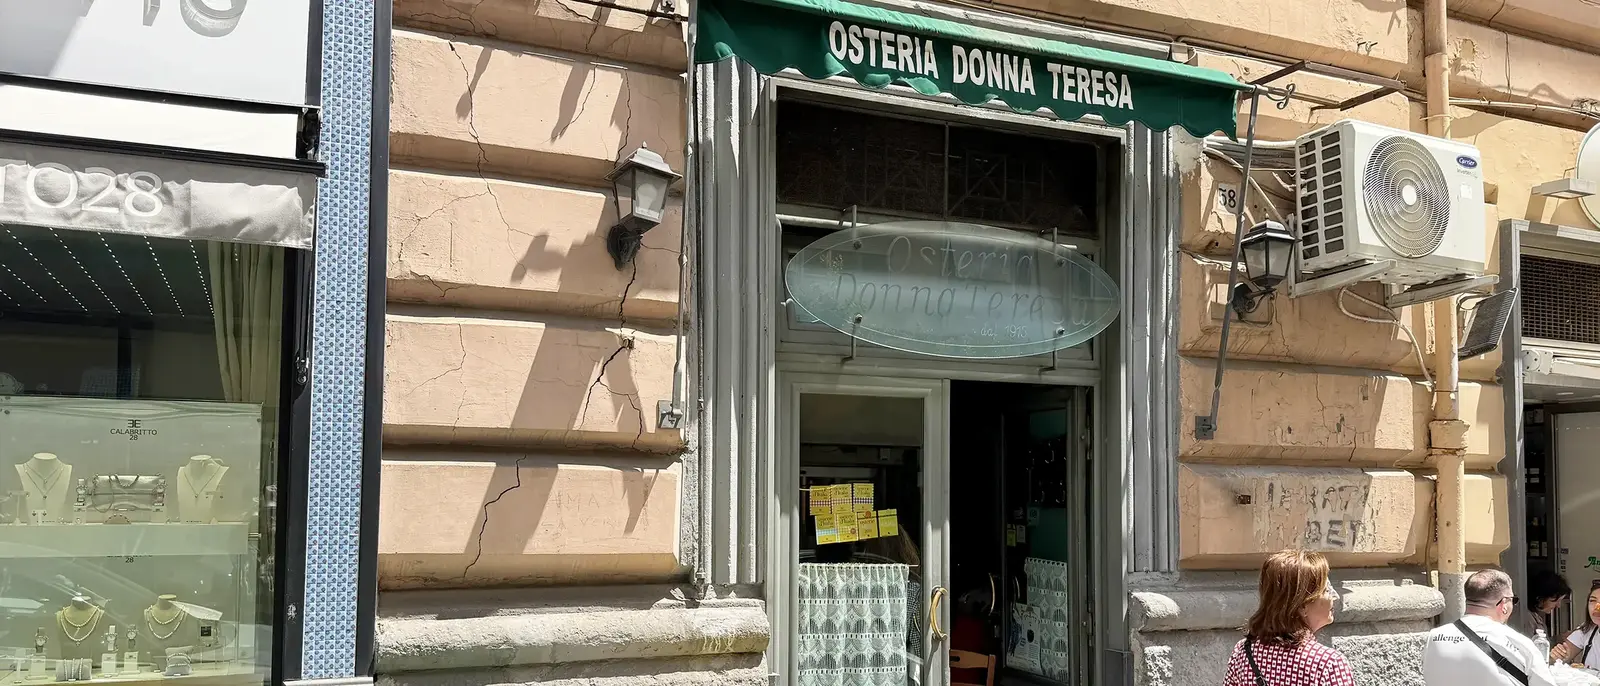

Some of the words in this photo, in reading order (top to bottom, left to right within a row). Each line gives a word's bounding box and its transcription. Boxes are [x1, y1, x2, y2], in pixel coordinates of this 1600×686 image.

[828, 20, 940, 80] OSTERIA
[952, 44, 1037, 96] DONNA
[1046, 61, 1135, 110] TERESA
[1217, 188, 1237, 209] 58
[887, 234, 1034, 280] Osteria
[834, 272, 957, 319] Donna
[1004, 324, 1028, 338] 1915
[109, 428, 158, 436] CALABRITTO
